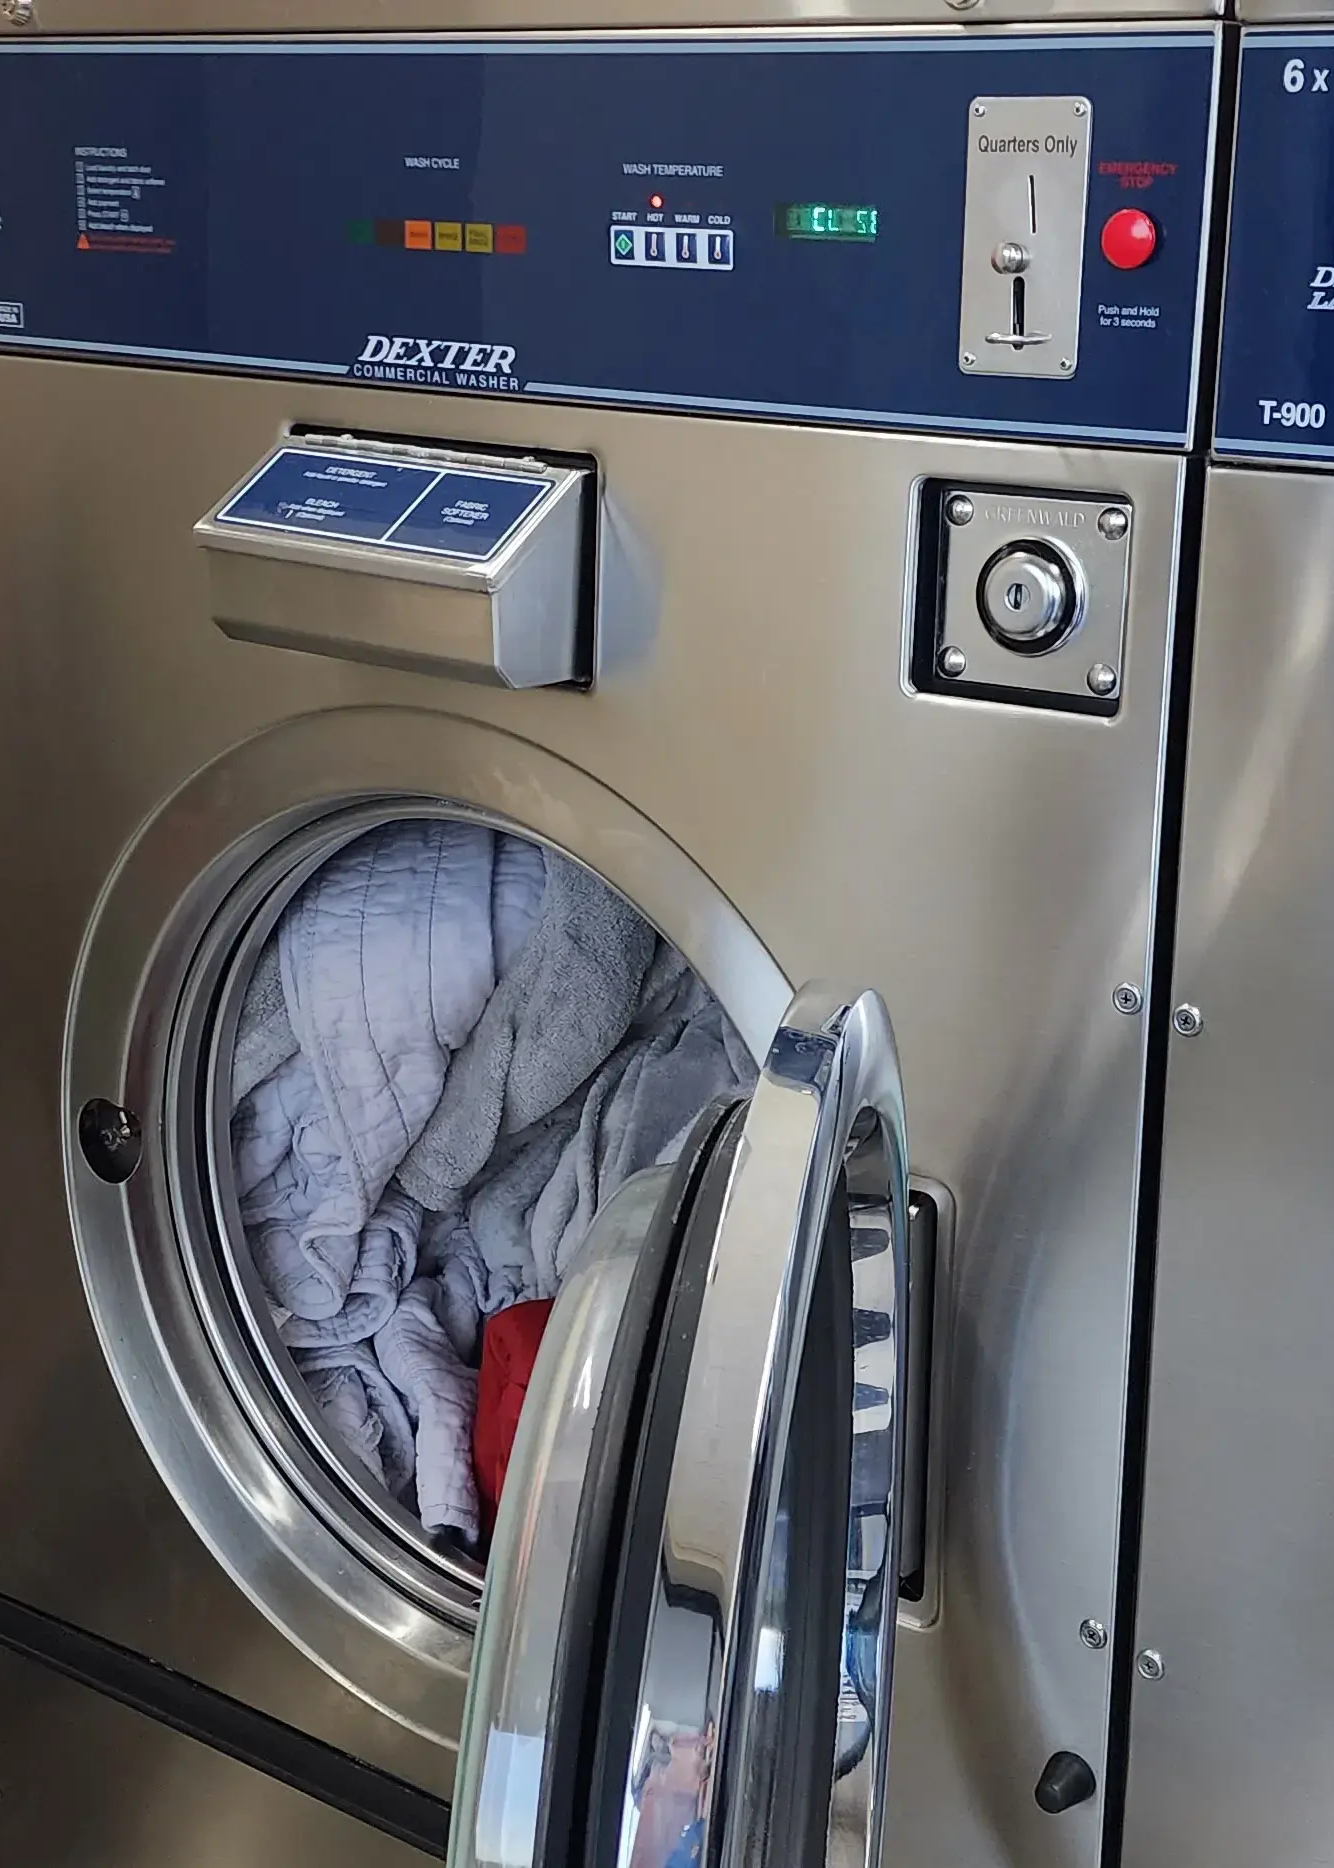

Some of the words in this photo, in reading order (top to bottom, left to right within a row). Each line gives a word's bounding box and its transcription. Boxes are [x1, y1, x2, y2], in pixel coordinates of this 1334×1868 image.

[1283, 58, 1305, 93] 6
[1311, 68, 1330, 92] x
[978, 135, 1040, 154] Quarters
[1044, 135, 1078, 157] Only
[404, 157, 431, 168] WASH
[431, 158, 460, 169] CYCLE
[1098, 161, 1179, 176] EMERGENCY
[622, 163, 651, 175] WASH
[652, 164, 724, 177] TEMPERATURE
[1120, 175, 1154, 189] STOP
[611, 211, 637, 221] START
[646, 213, 664, 222] HOT
[674, 214, 701, 224] WARM
[708, 215, 731, 225] COLD
[1098, 304, 1120, 315] Push
[1121, 305, 1138, 316] and
[1139, 306, 1160, 317] Hold
[1099, 316, 1111, 326] for
[1113, 316, 1120, 327] 3
[1121, 317, 1156, 328] seconds
[357, 335, 517, 374] DEXTER
[353, 363, 450, 385] COMMERCIAL
[456, 372, 519, 391] WASHER
[1258, 400, 1326, 428] T-900
[304, 498, 341, 509] BLEACH
